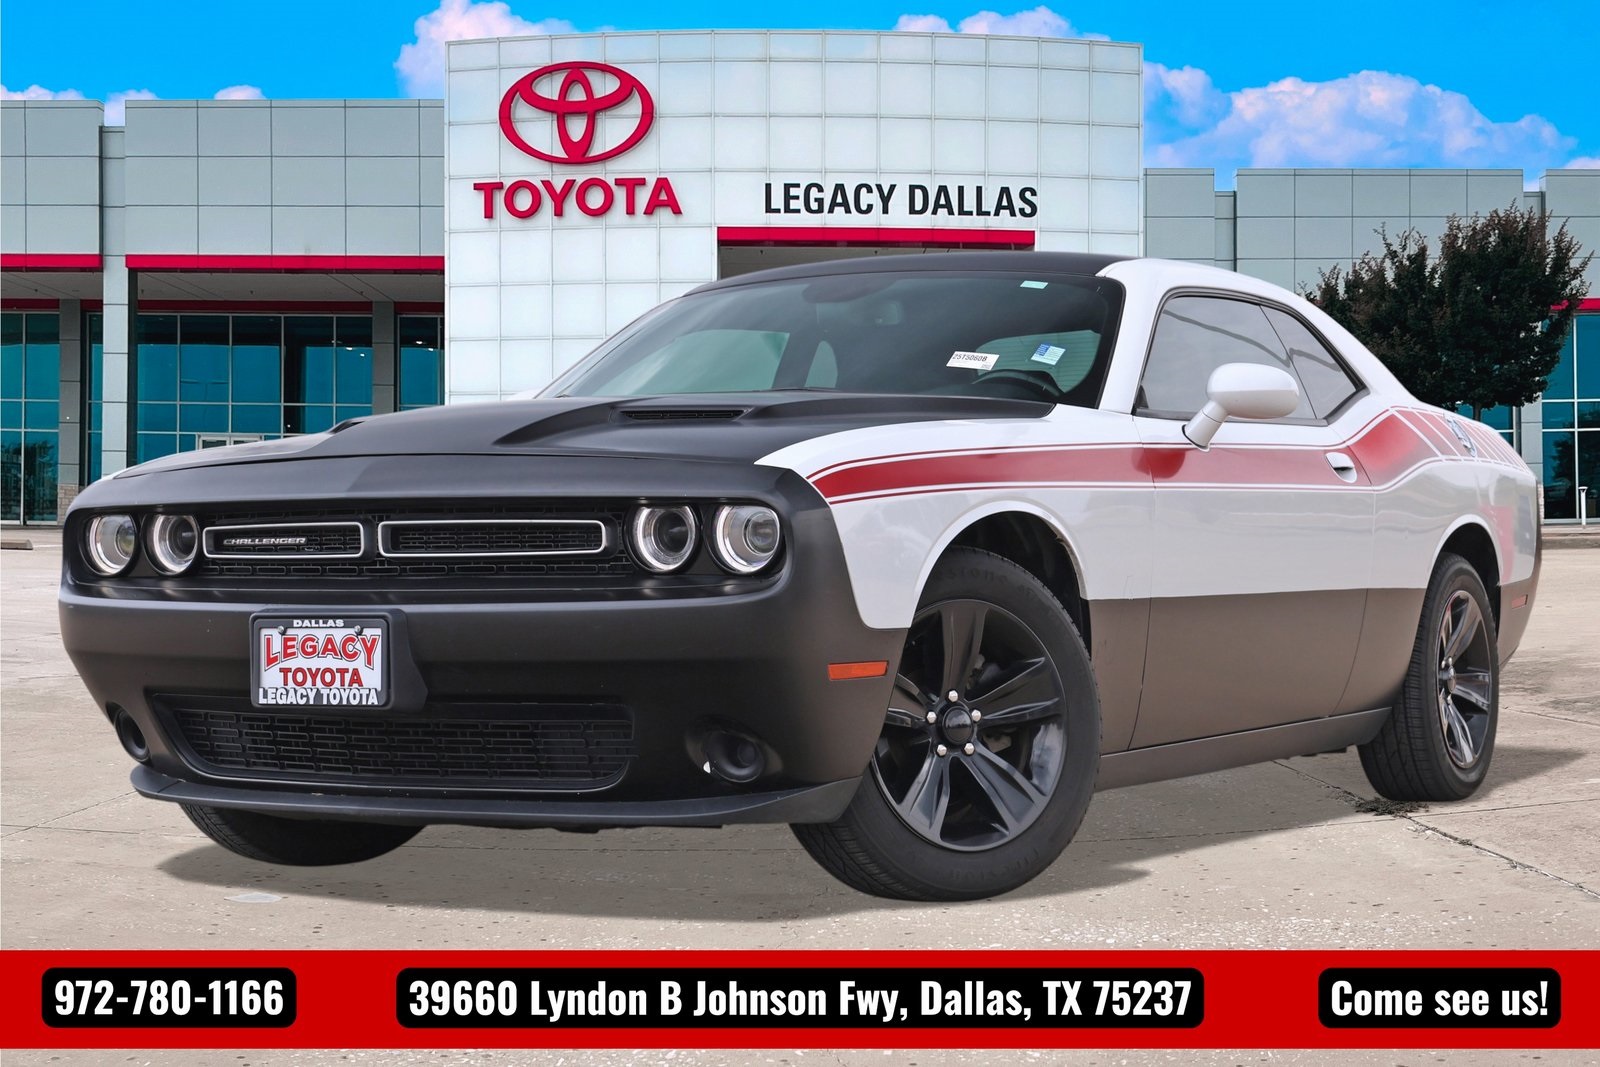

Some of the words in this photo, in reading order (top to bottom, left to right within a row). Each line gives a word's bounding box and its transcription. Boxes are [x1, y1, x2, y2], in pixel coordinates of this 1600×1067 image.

[475, 178, 681, 218] TOYOTA
[765, 183, 896, 214] LEGACY
[909, 185, 1037, 217] DALLAS
[223, 537, 306, 545] CHALLENGER
[293, 619, 345, 628] DALLAS
[264, 634, 380, 672] LEGACY
[279, 667, 364, 687] TOYOTA
[259, 687, 318, 705] LEGACY
[320, 687, 379, 705] TOYOTA
